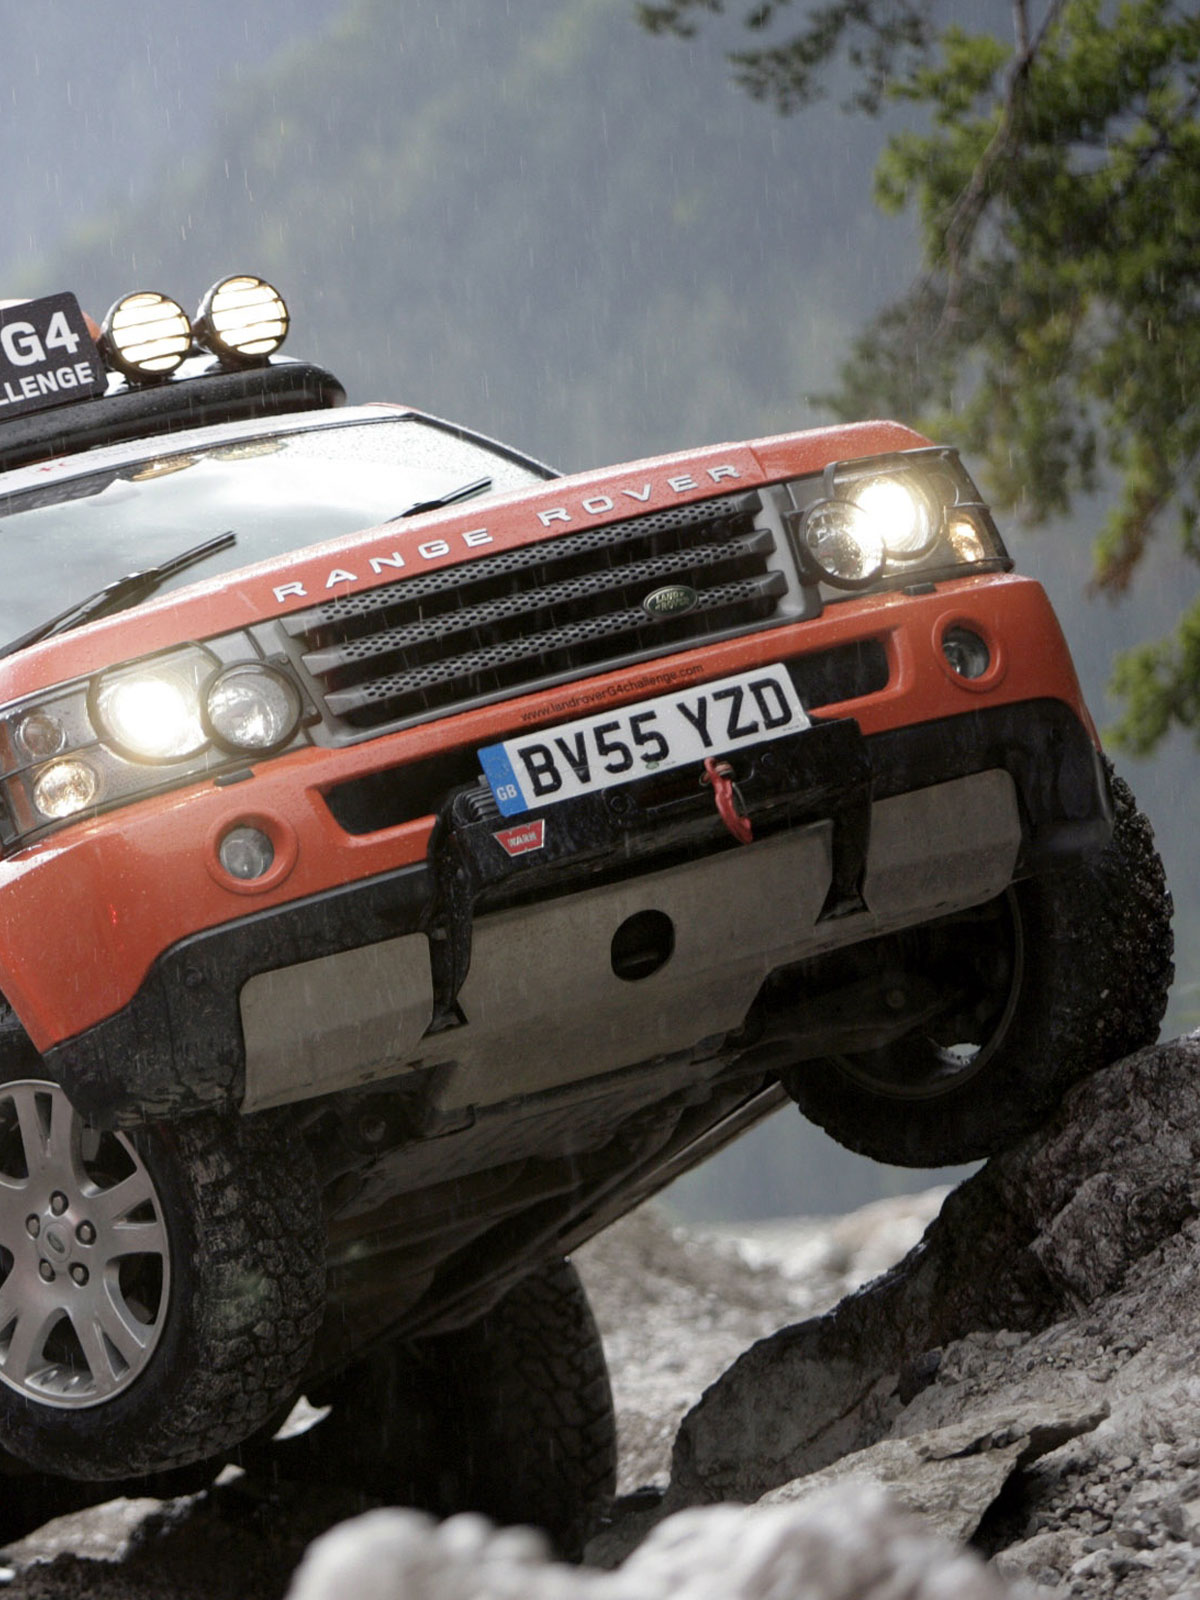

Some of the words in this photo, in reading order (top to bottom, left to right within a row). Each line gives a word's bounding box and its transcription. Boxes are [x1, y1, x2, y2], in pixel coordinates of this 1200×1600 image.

[0, 311, 80, 366] G4
[272, 528, 494, 602] RANGE
[536, 464, 742, 527] ROVER
[521, 663, 704, 721] www.landroverG4challenge.com
[517, 710, 669, 797] BV55
[676, 677, 793, 748] YZD
[496, 784, 517, 801] GB
